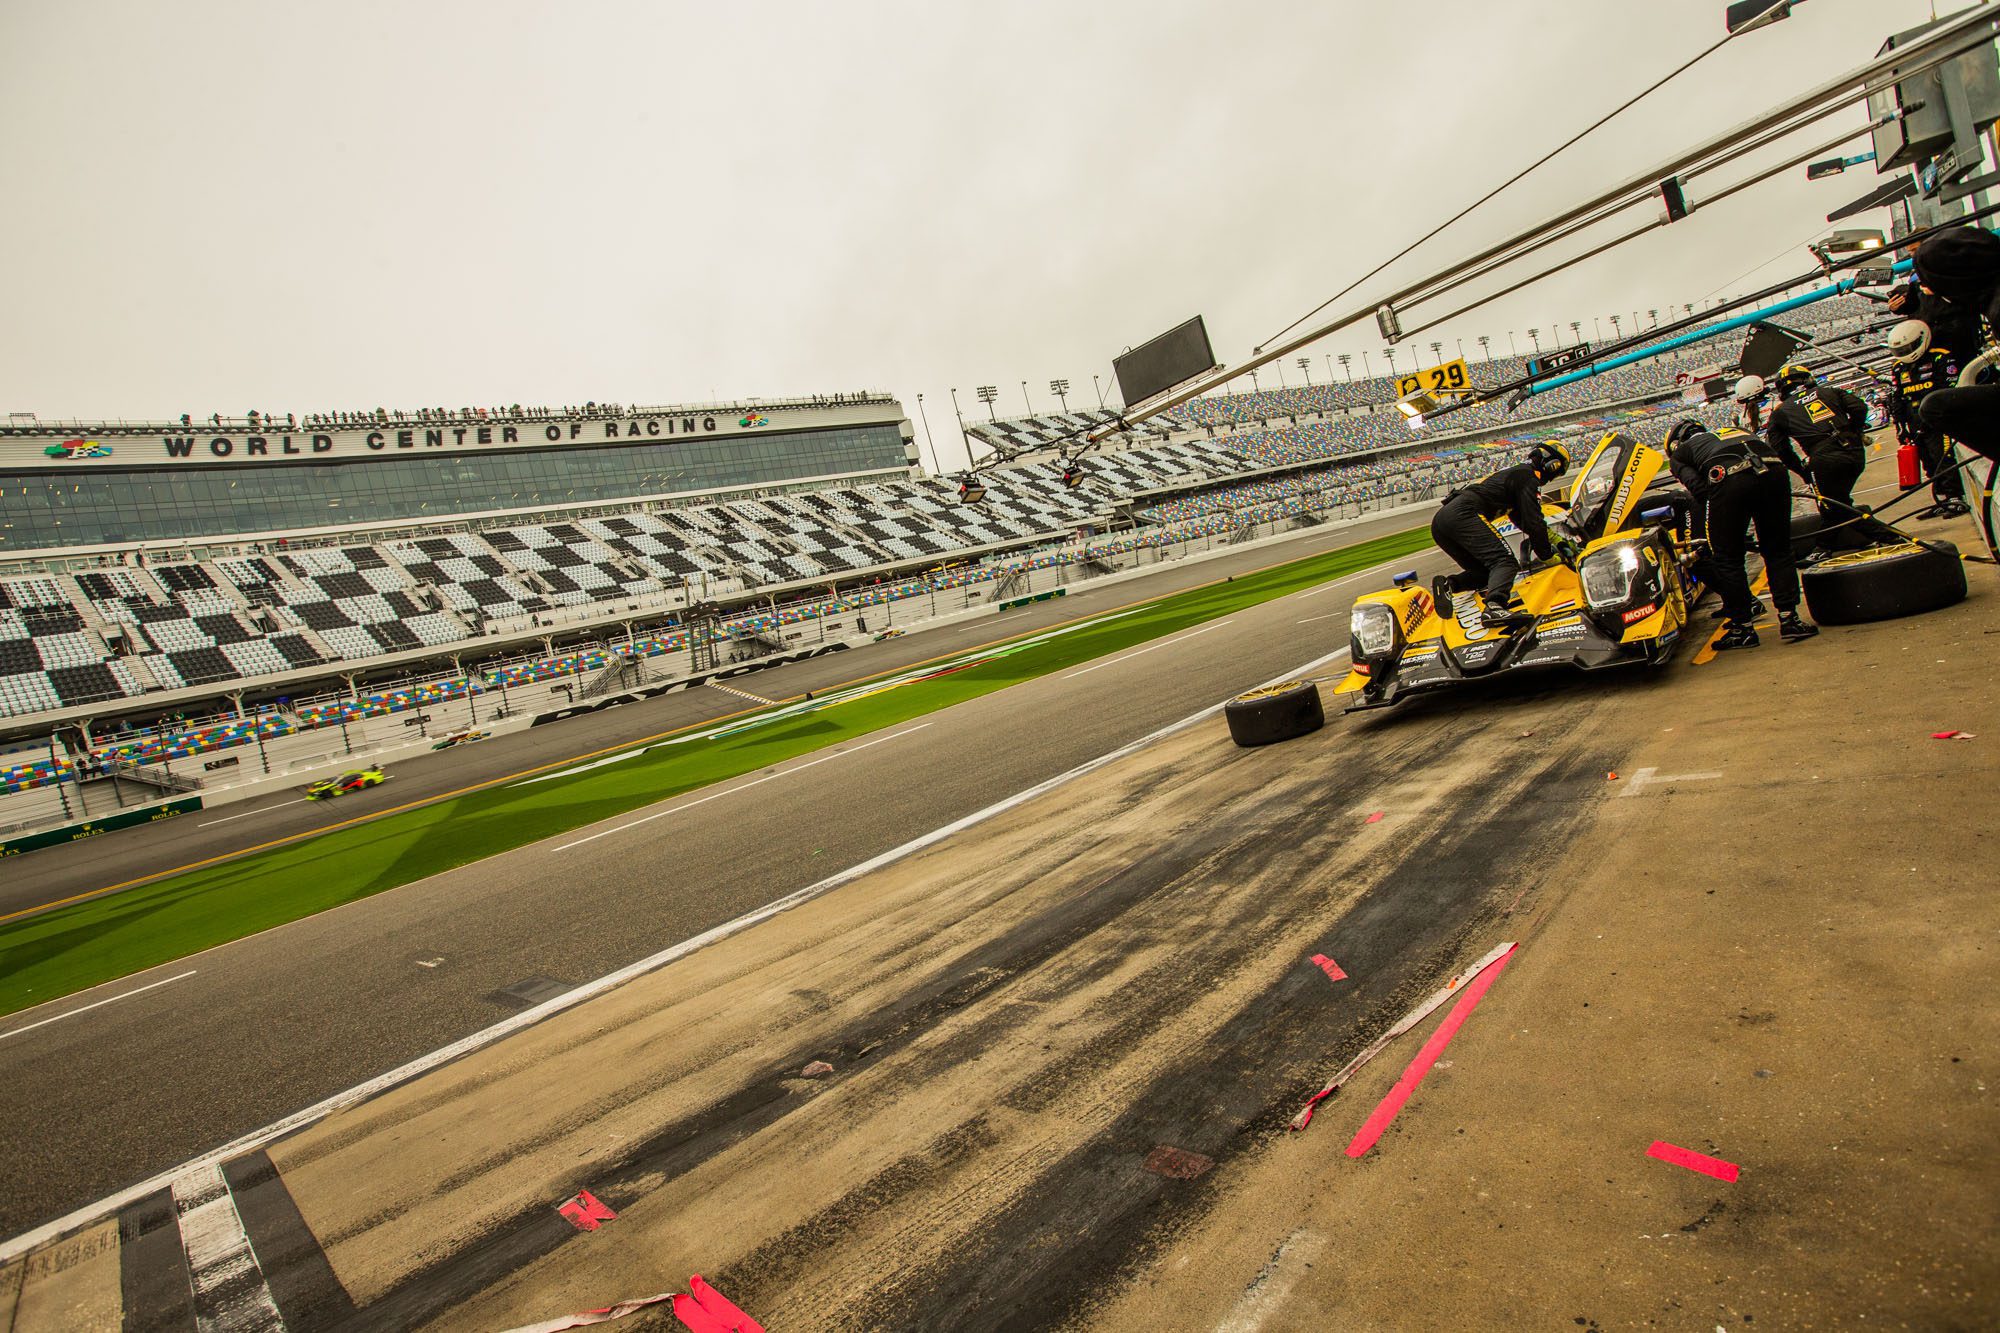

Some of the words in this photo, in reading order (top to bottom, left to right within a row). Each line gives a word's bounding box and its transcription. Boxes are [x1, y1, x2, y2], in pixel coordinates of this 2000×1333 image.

[1431, 364, 1464, 389] 29
[1679, 375, 1695, 386] 20
[1903, 381, 1934, 395] UMBO
[164, 434, 332, 457] WORLD
[366, 426, 517, 450] CENTER
[546, 424, 582, 441] OF
[605, 417, 716, 438] RACING
[1609, 447, 1646, 526] JUMBO.com
[1452, 590, 1490, 640] UMBO
[1624, 605, 1656, 622] MOTUL
[1536, 624, 1587, 639] HESSING
[530, 642, 852, 728] DAYTONA
[152, 809, 182, 821] ROLEX
[72, 828, 105, 840] ROLEX
[0, 848, 21, 858] LEX
